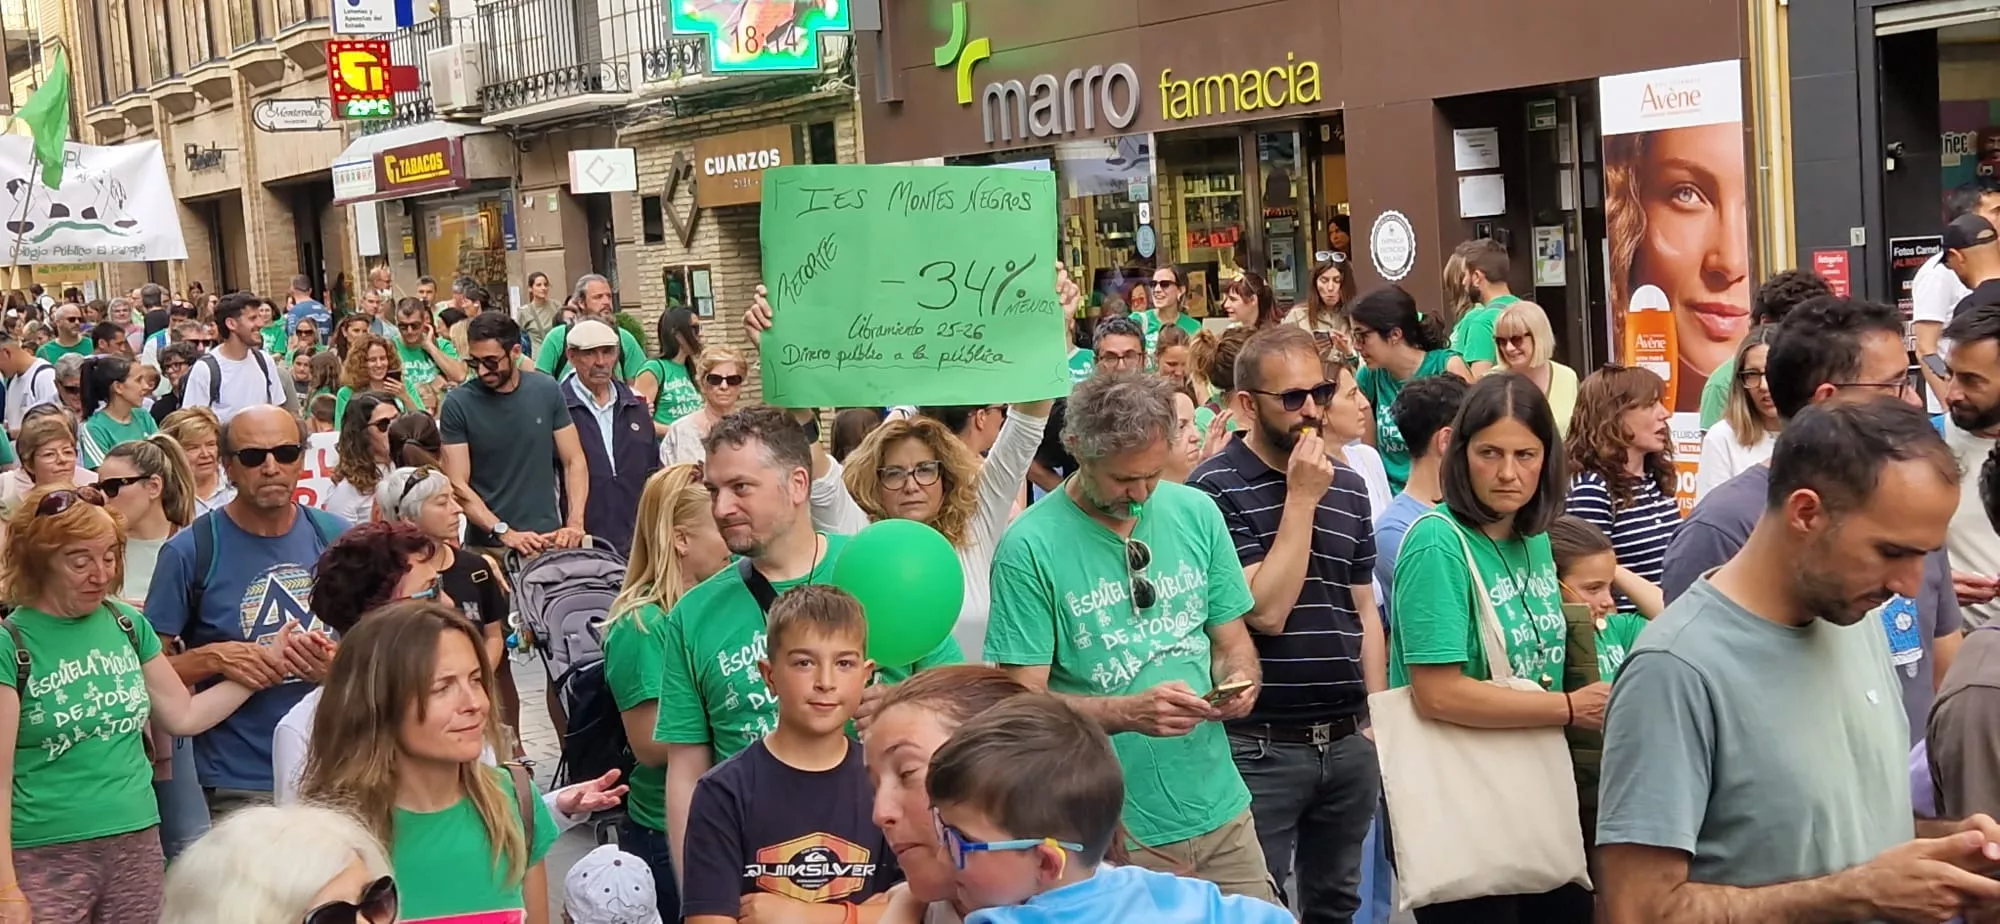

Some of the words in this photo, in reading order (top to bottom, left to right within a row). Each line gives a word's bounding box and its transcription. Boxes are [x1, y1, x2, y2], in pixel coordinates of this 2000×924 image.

[731, 25, 799, 54] 18:14
[1159, 51, 1321, 120] farmacia
[1641, 82, 1701, 111] Avène
[982, 62, 1140, 143] marro
[399, 152, 444, 176] TABACOS
[704, 148, 780, 175] CUARZOS
[796, 187, 868, 218] IES
[888, 180, 954, 216] MONTES
[960, 177, 1031, 214] NEGROS
[777, 232, 838, 311] RECORTE
[1003, 301, 1055, 317] MENOS
[848, 313, 924, 339] Libramiento
[937, 322, 986, 339] 25-26
[1635, 333, 1666, 349] Avène
[781, 344, 830, 365] Dinero
[894, 352, 904, 360] a
[912, 344, 928, 360] la
[938, 344, 1014, 371] pública
[1069, 580, 1129, 617] ESCUEL
[1154, 570, 1207, 600] ÚBLICA:
[1489, 573, 1529, 607] SCUELA
[1101, 628, 1129, 650] DE
[1137, 611, 1201, 638] TOD@S
[1511, 622, 1529, 647] DE
[719, 635, 768, 677] ESCU
[29, 655, 99, 697] ESCUELA
[54, 703, 83, 728] DE
[743, 863, 876, 878] QUIKSILVER
